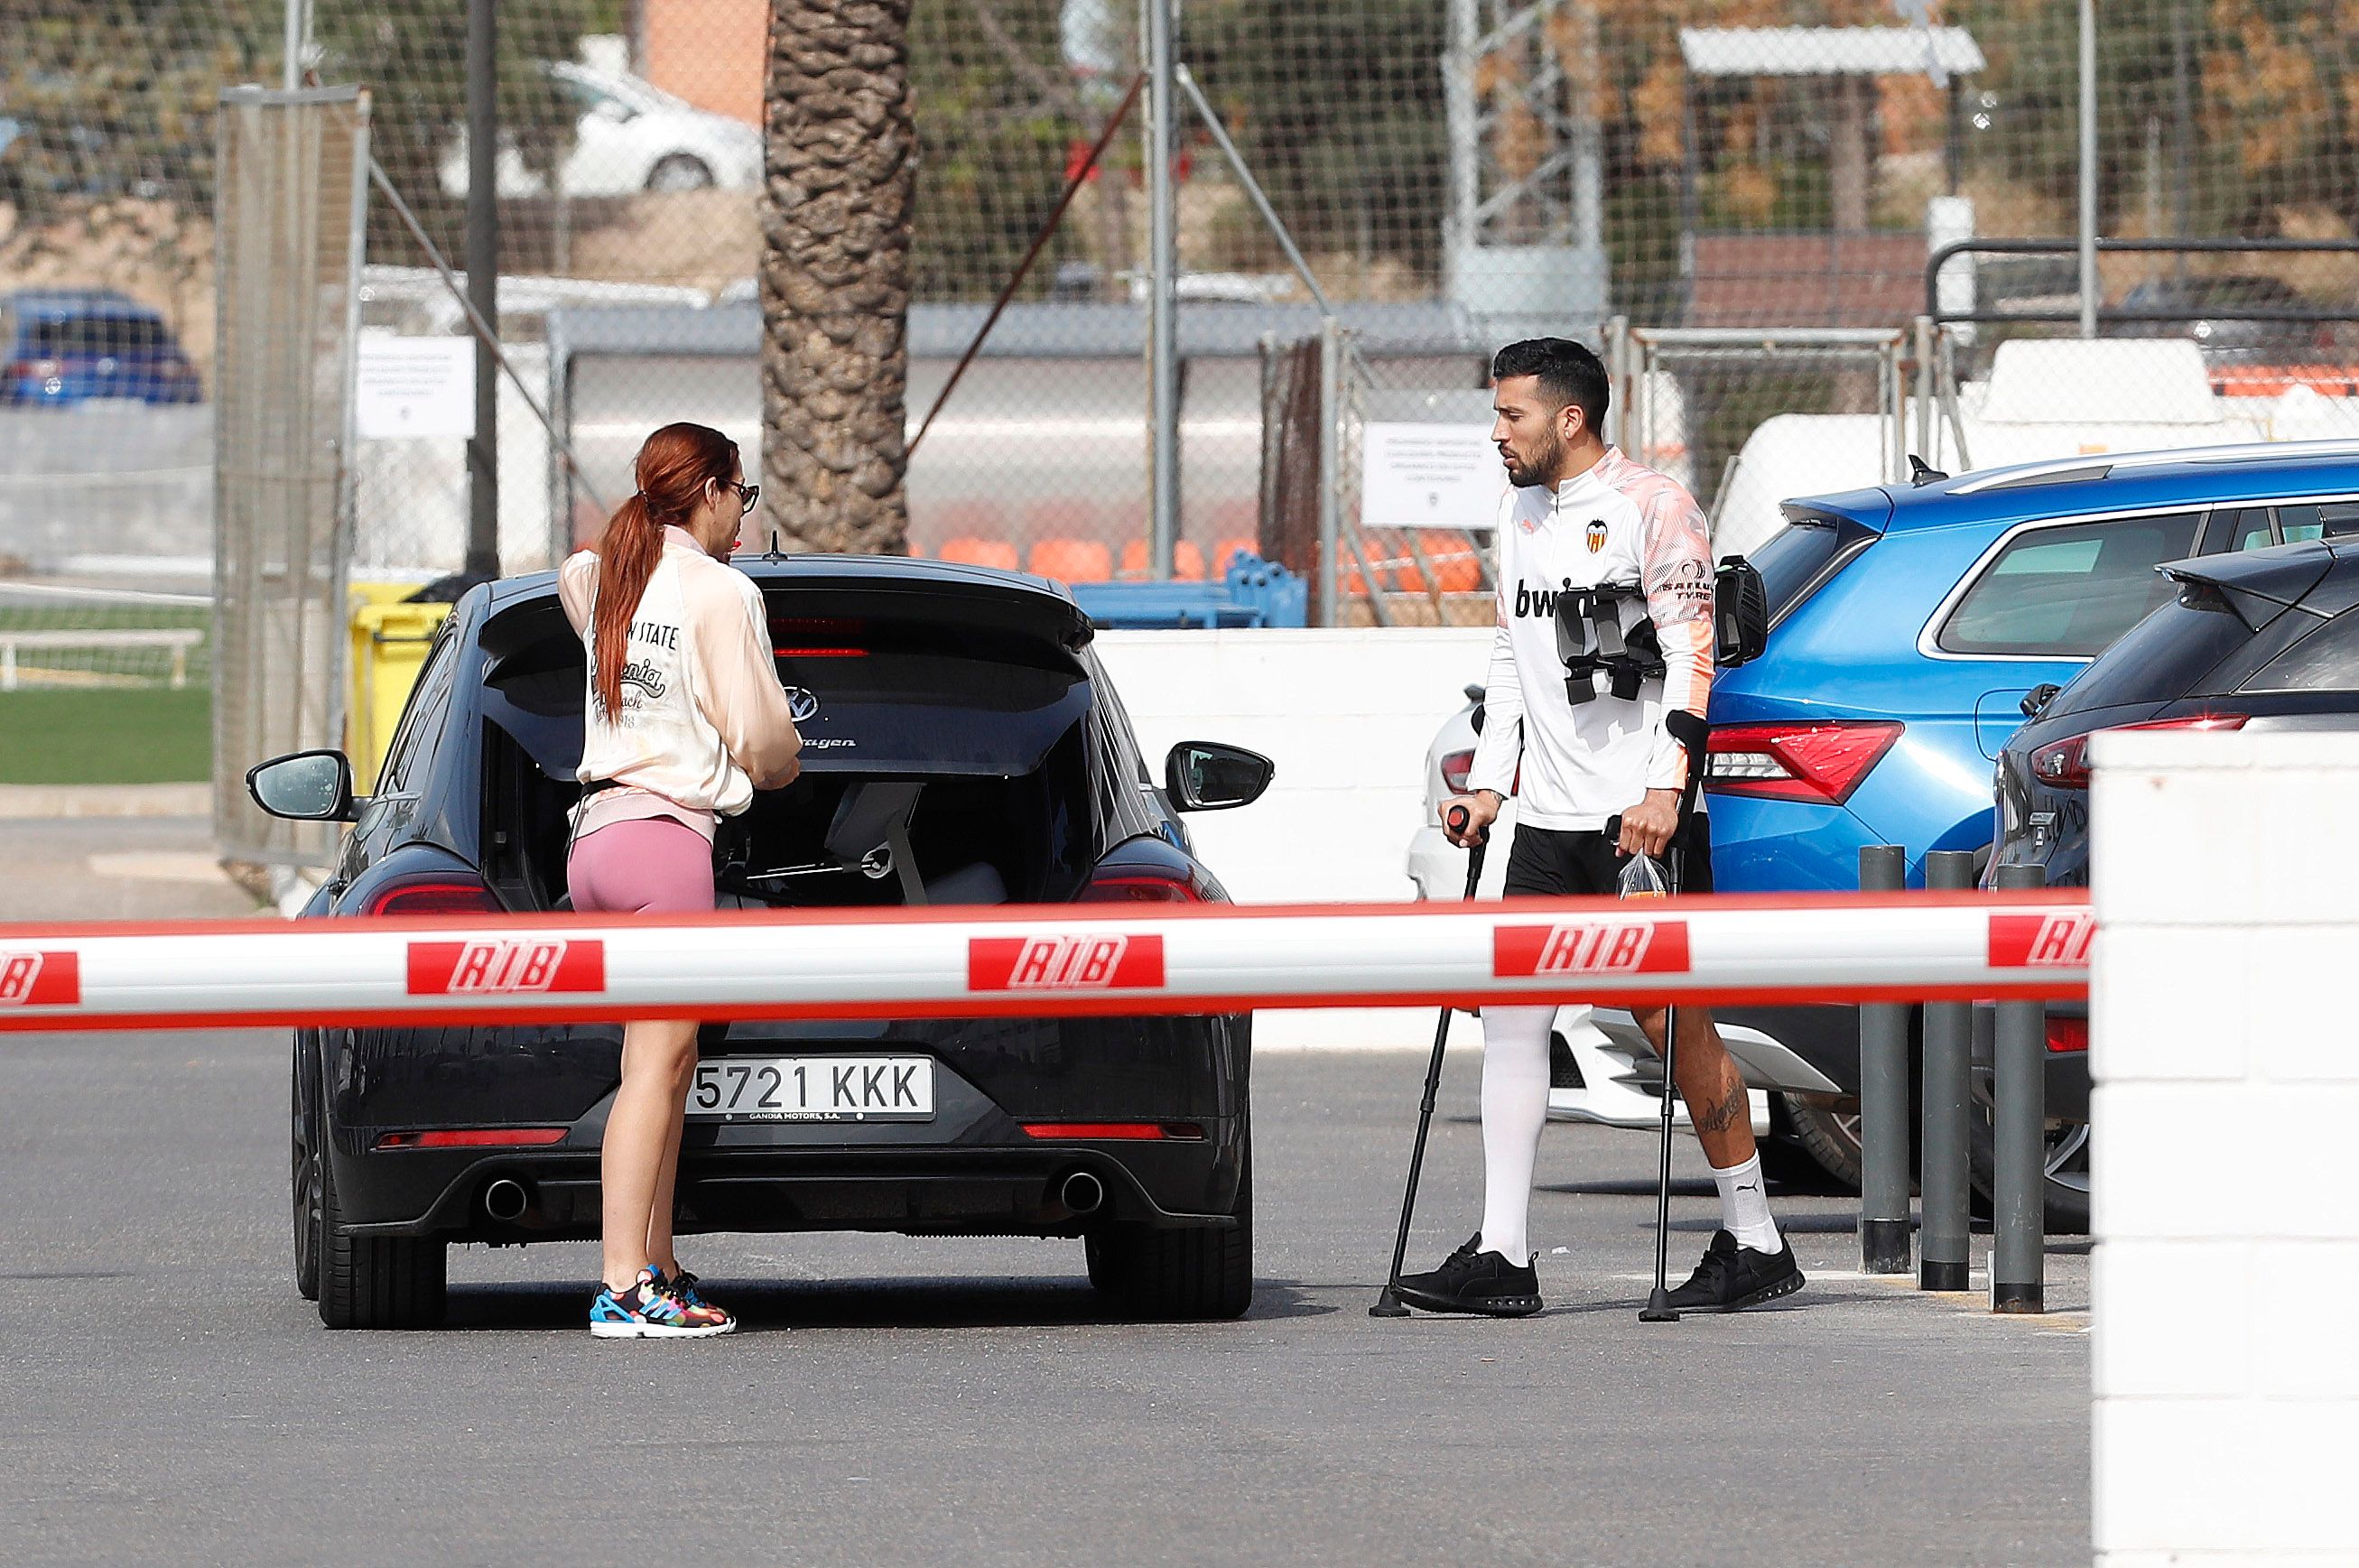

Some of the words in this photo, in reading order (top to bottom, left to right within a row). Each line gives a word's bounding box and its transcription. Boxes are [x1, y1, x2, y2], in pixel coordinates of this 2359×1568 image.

[639, 621, 680, 651] STATE
[620, 690, 643, 710] ach
[1008, 935, 1128, 988] RIB
[1537, 923, 1655, 974] RIB
[2026, 914, 2094, 965] RI
[448, 942, 567, 993] RIB
[695, 1065, 807, 1109] 5721
[832, 1065, 918, 1108] KKK
[748, 1112, 783, 1120] GANDIA
